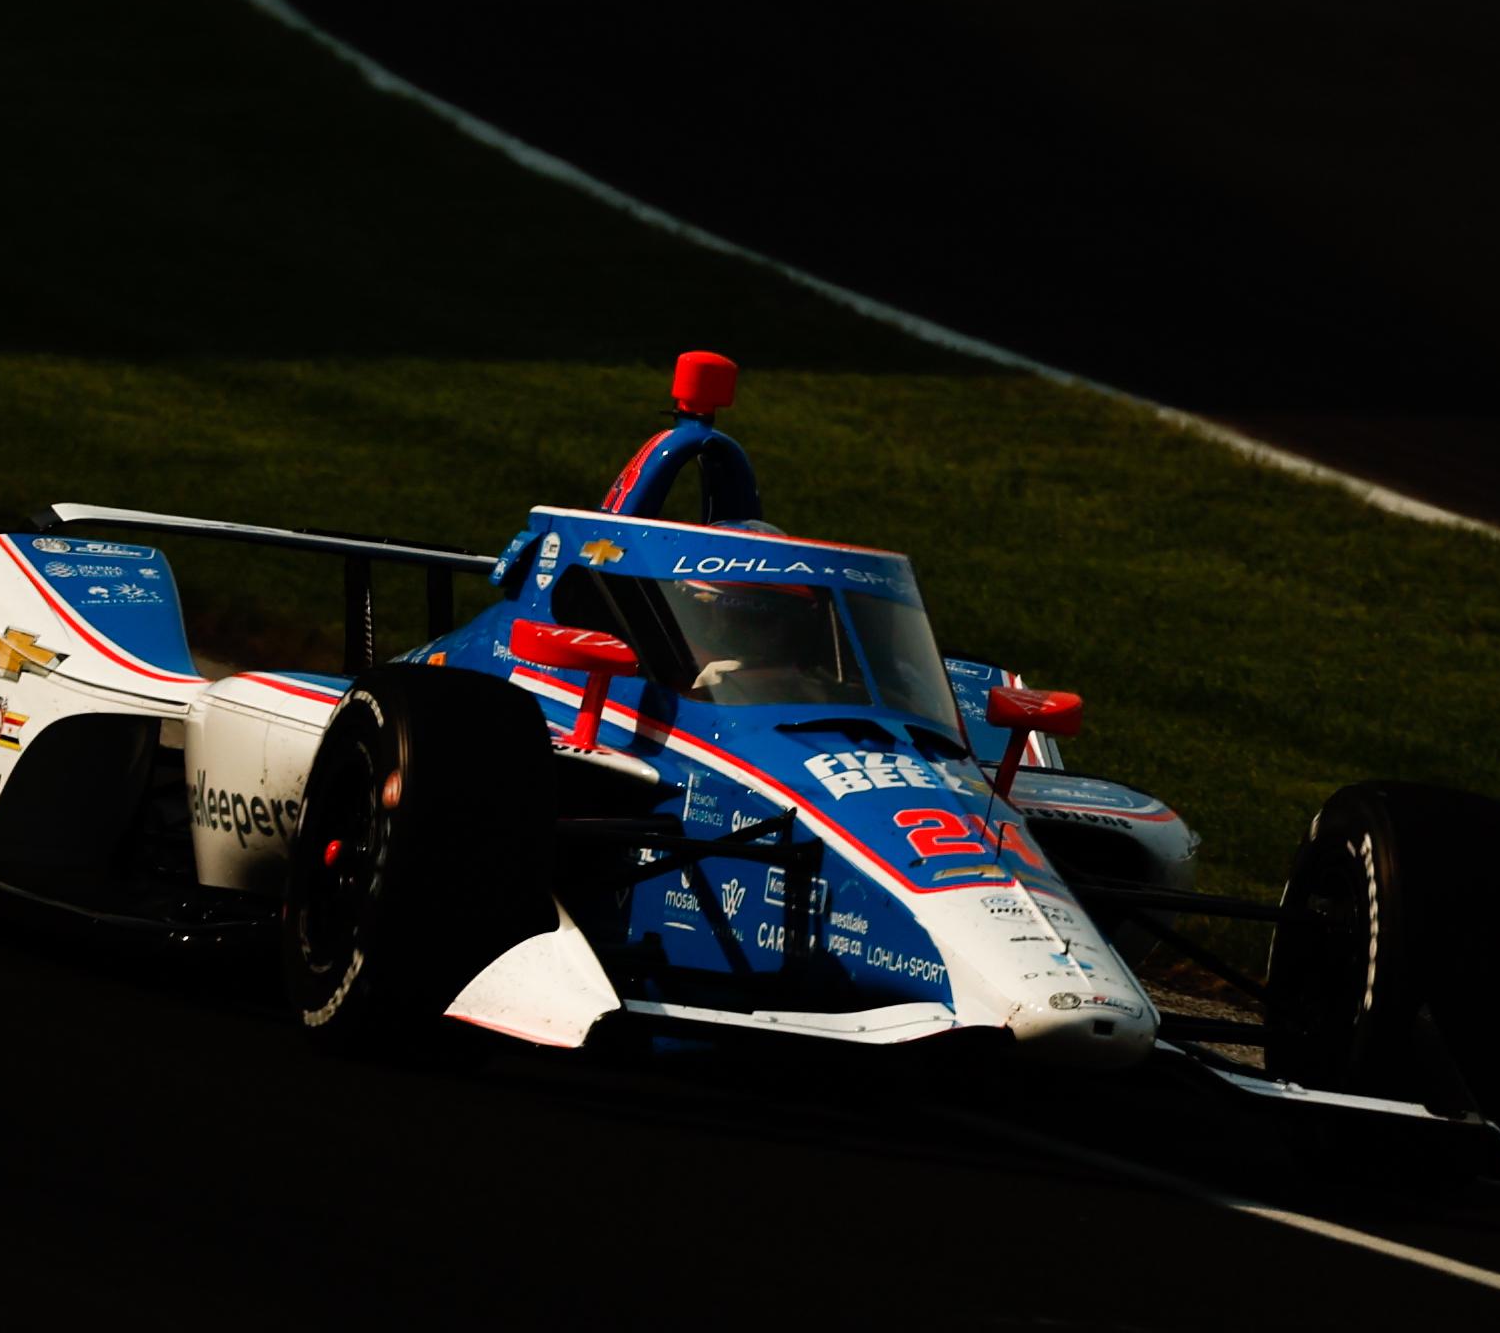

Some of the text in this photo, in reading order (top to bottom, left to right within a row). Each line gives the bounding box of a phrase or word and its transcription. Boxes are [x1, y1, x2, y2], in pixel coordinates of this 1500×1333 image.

[672, 555, 815, 575] LOHLA
[866, 944, 946, 985] LOHLA SPORT
